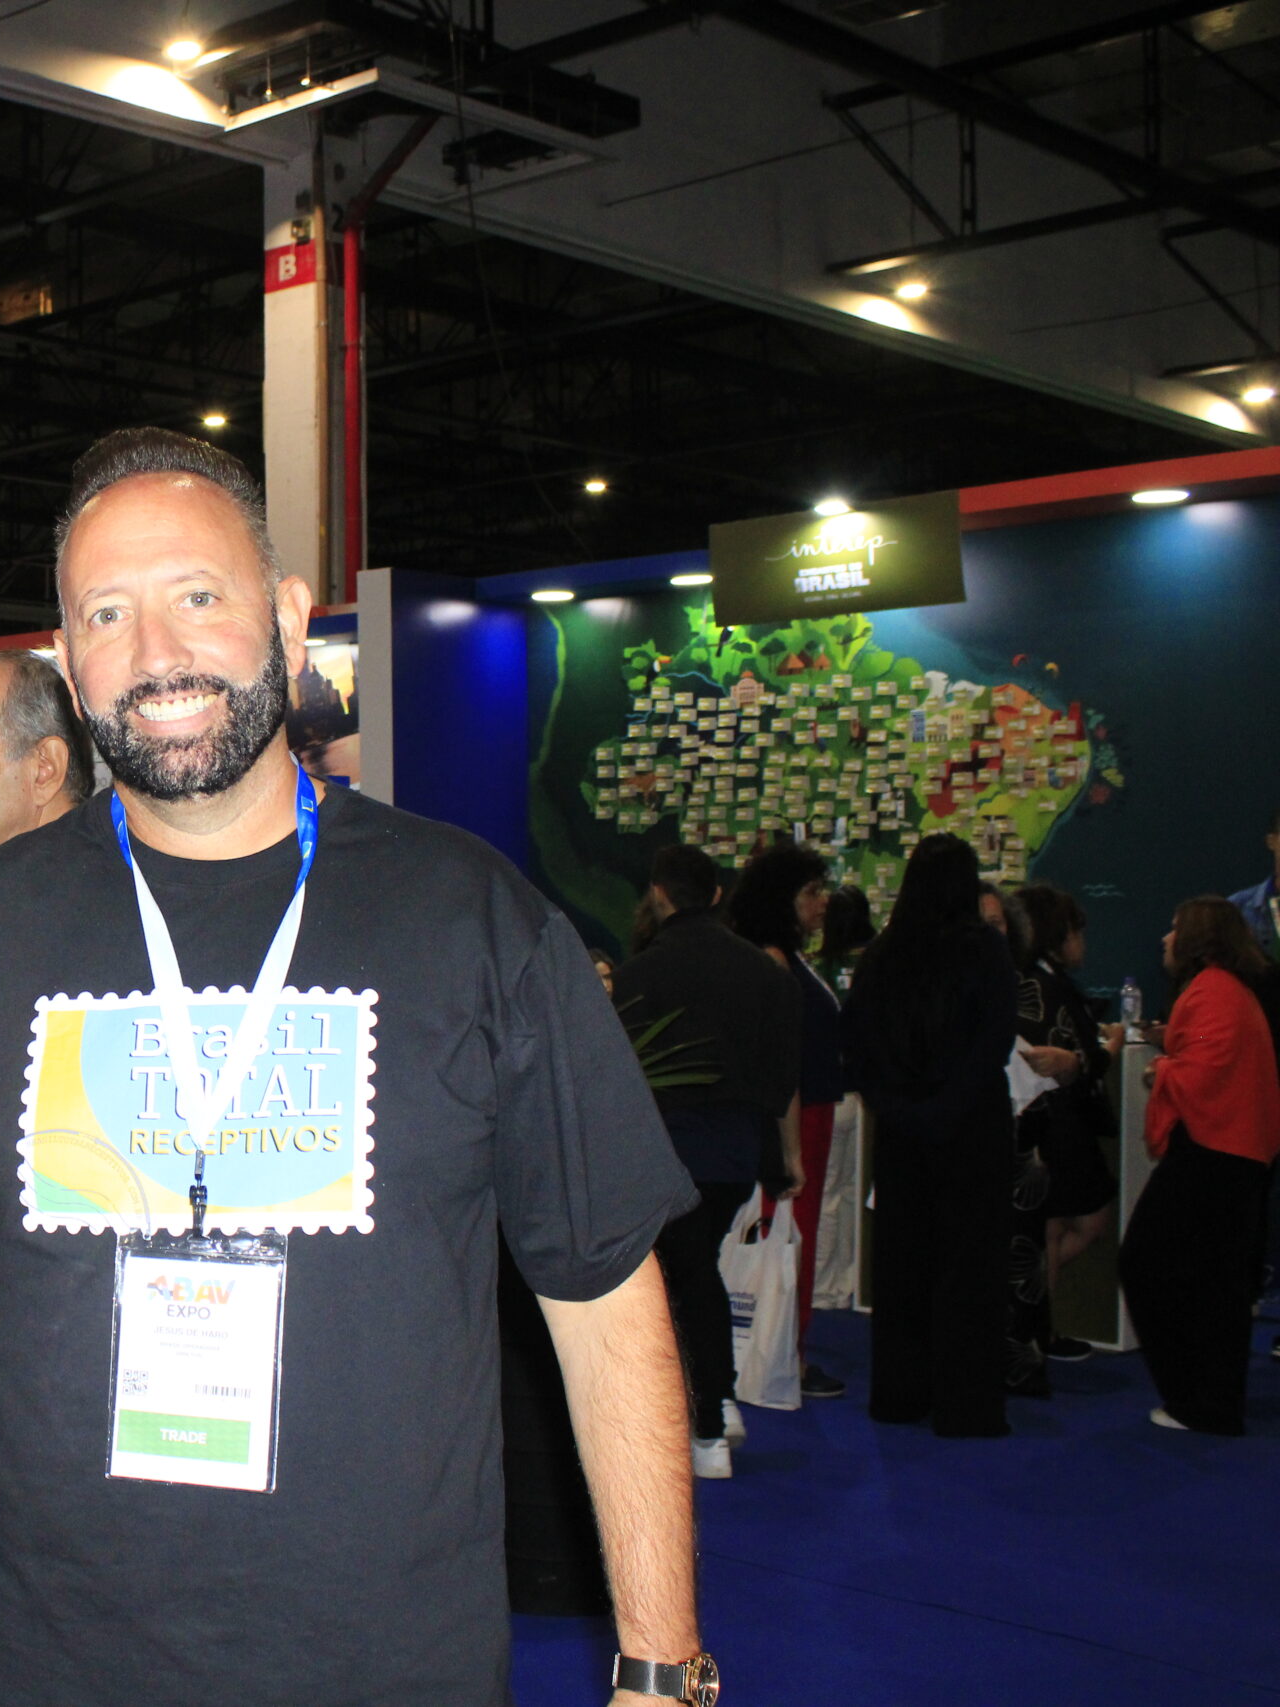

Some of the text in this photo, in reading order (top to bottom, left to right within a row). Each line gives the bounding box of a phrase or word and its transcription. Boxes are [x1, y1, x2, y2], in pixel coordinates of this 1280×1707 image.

[278, 253, 298, 283] B
[129, 1010, 342, 1059] Bail
[129, 1124, 344, 1156] RECEPTIVOS
[147, 1275, 237, 1305] ABAV
[167, 1304, 212, 1321] EXPO
[160, 1427, 208, 1445] TRADE
